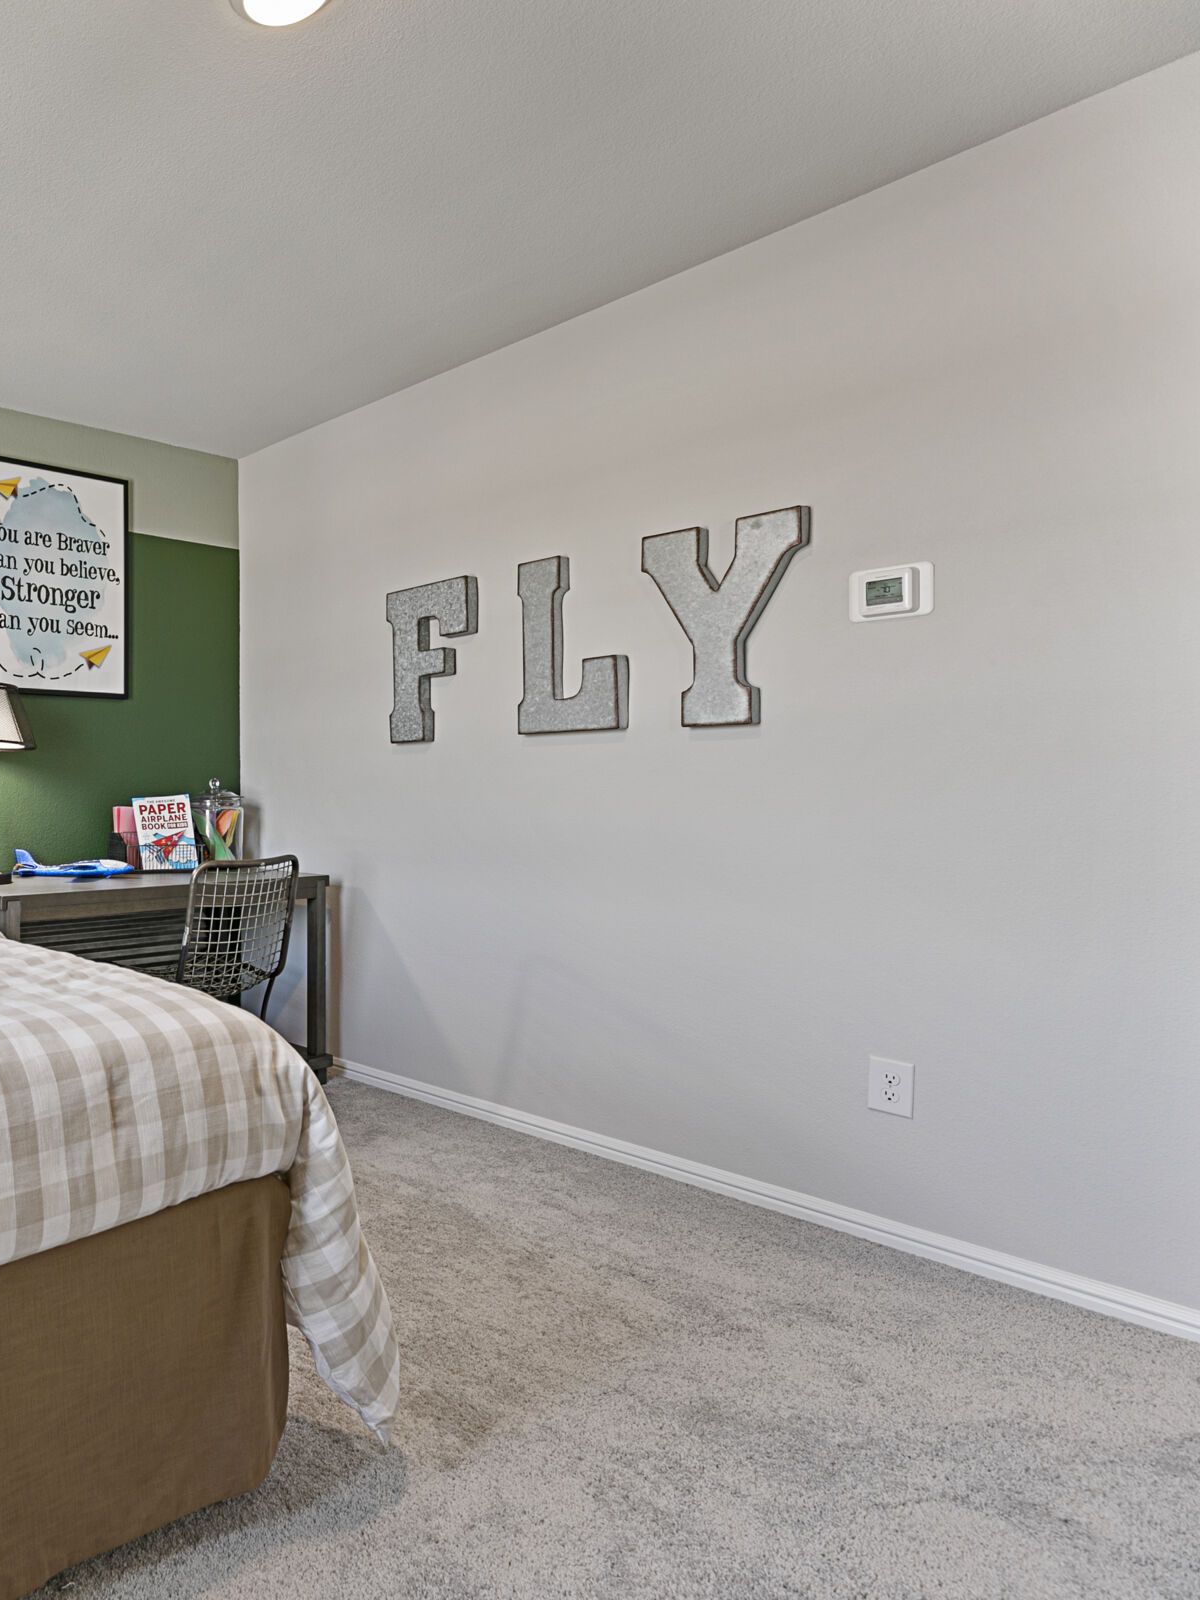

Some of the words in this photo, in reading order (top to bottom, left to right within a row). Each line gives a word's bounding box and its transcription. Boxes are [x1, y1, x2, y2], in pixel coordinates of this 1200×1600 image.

[24, 530, 52, 548] are
[56, 533, 110, 556] Braver
[23, 556, 55, 576] you
[60, 558, 120, 585] believe,
[0, 576, 100, 613] Stronger
[27, 617, 61, 636] you
[66, 619, 119, 639] seem...
[386, 505, 811, 744] FLY
[139, 802, 186, 815] PAPER
[141, 814, 187, 823] AIRPLANE
[141, 822, 166, 830] BOOK
